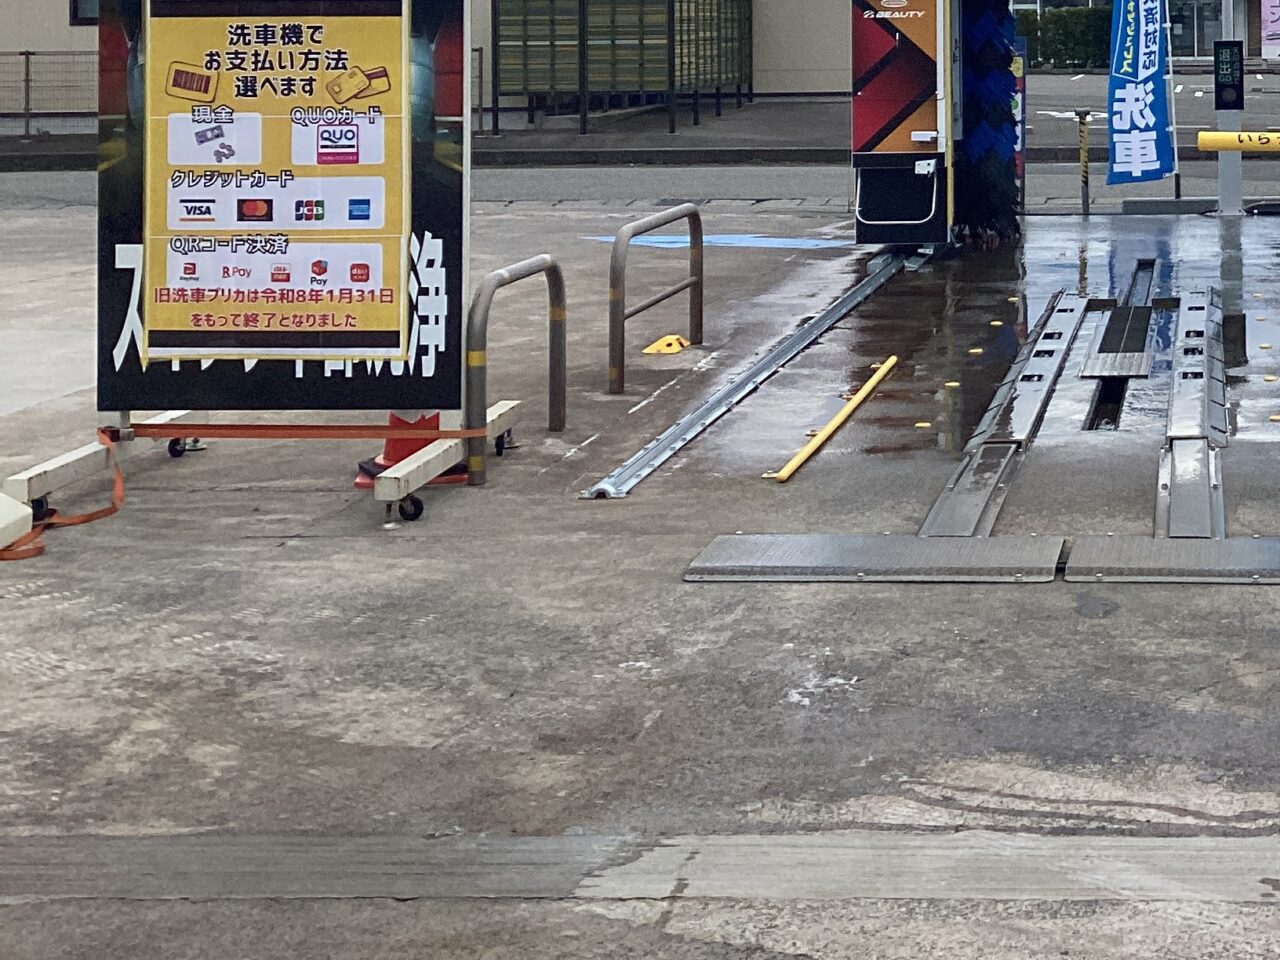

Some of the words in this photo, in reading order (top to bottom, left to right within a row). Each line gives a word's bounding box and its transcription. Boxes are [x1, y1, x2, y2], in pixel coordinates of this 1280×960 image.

[876, 10, 925, 19] BEAUTY
[227, 23, 324, 46] 洗車機で
[204, 48, 349, 72] お支払い方法
[234, 76, 317, 98] 選べます
[192, 104, 234, 124] 現金
[291, 106, 383, 126] QUOカード
[320, 129, 356, 144] QUO
[171, 170, 294, 188] クレジットカード
[183, 205, 212, 216] VISA
[295, 204, 324, 217] JCB
[170, 234, 289, 255] QRコード決済
[232, 266, 252, 278] Pay
[310, 276, 328, 286] Pay
[153, 287, 394, 305] 旧洗車プリカは令和8年1月31日
[191, 312, 357, 329] をもって終了となりました
